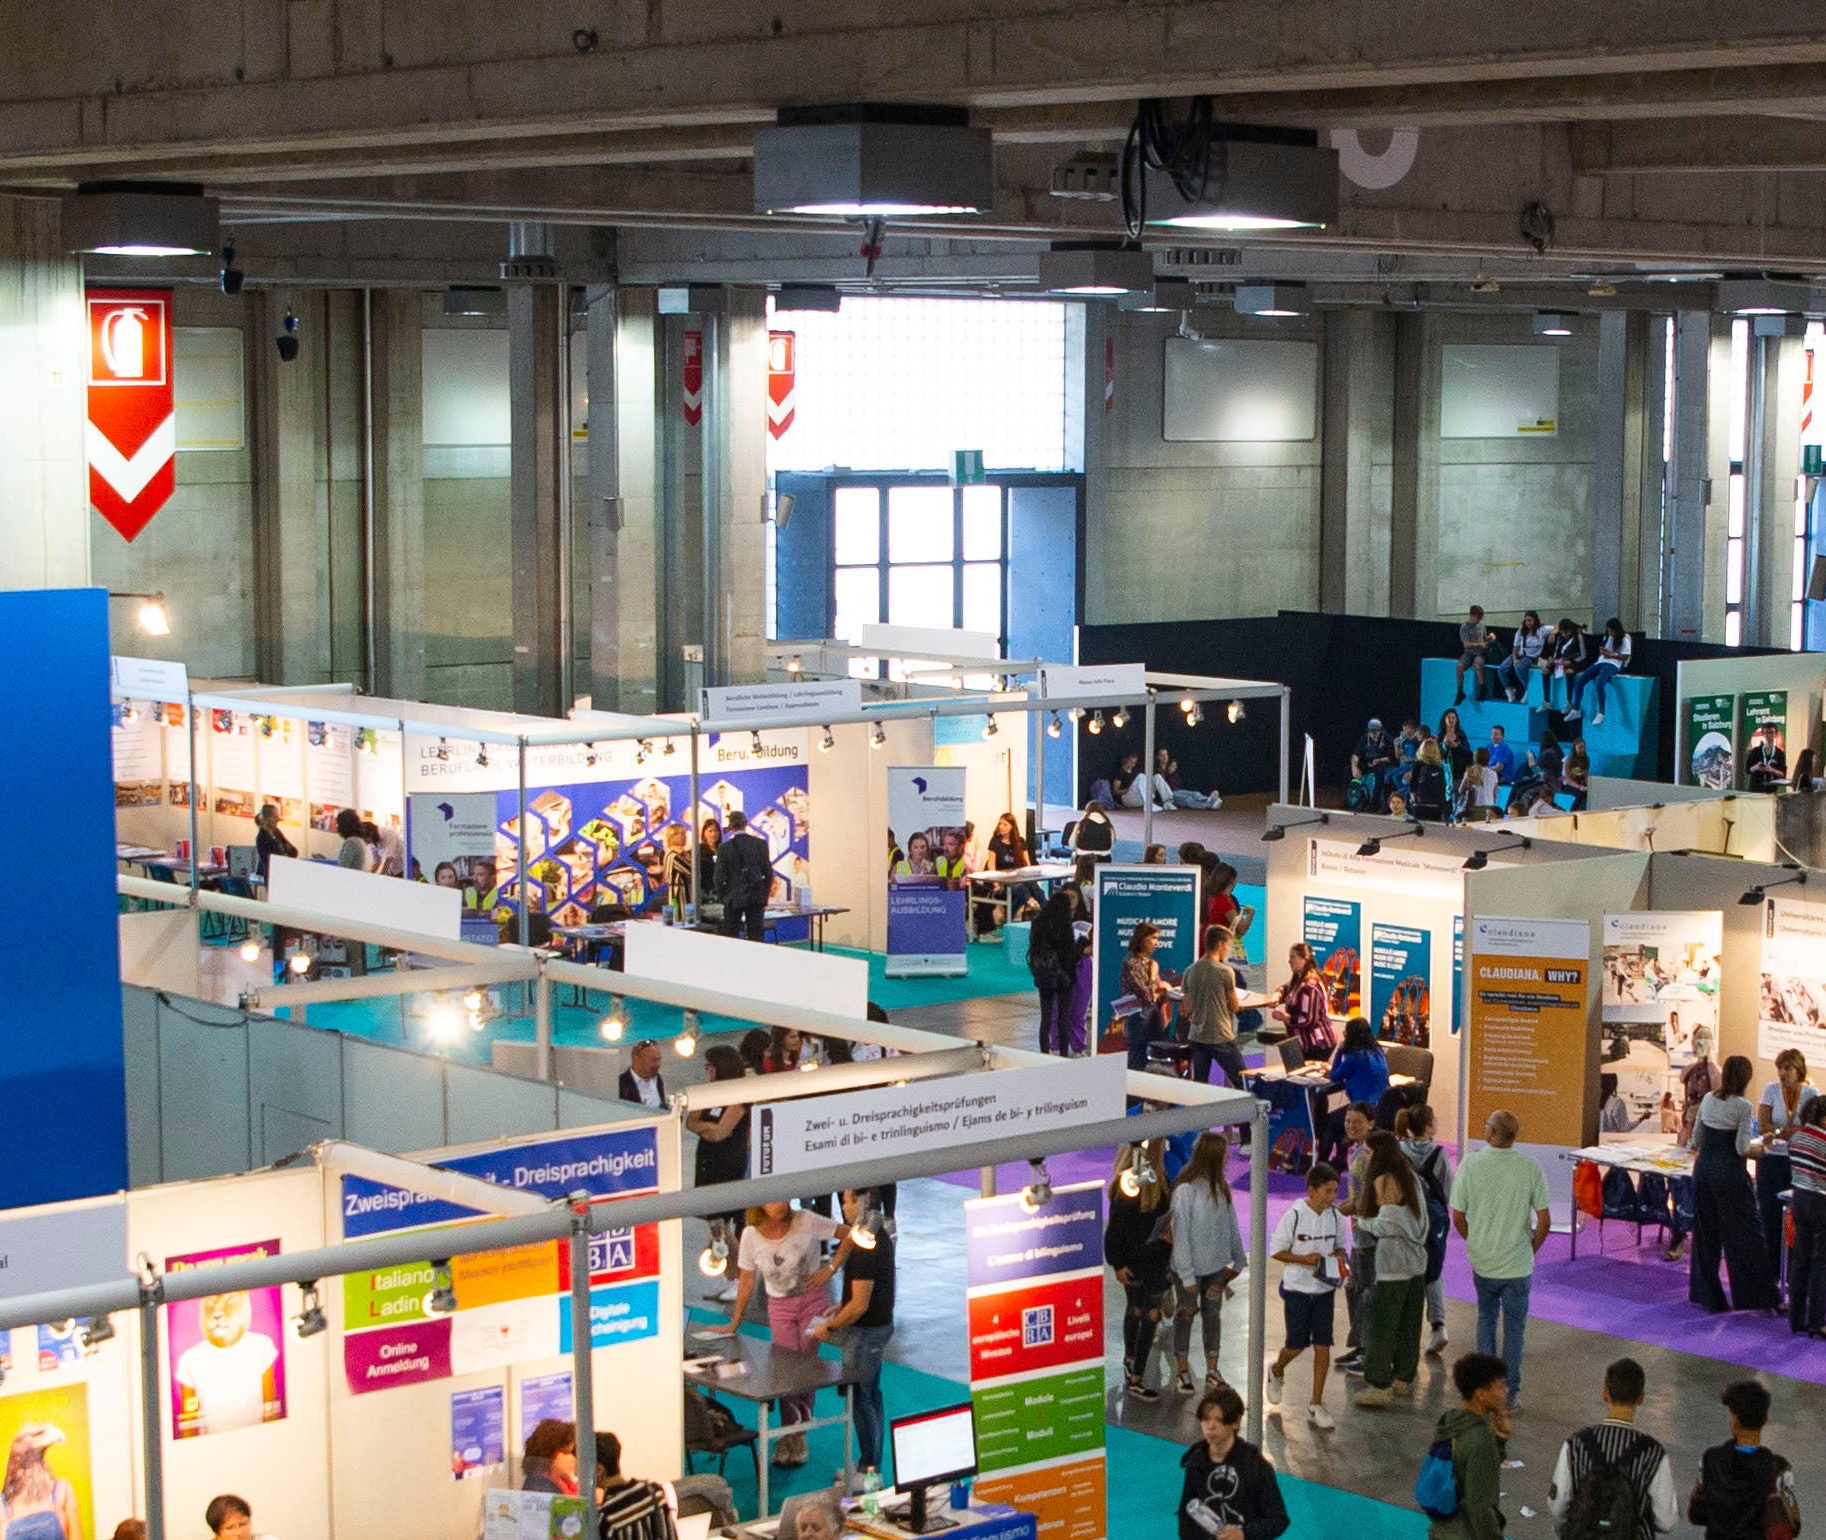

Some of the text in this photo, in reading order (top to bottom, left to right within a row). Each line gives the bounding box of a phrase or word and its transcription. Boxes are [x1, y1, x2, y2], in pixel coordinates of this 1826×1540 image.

[890, 895, 943, 906] LEHRLINGS-
[891, 904, 947, 915] AUSBILDUNG
[1488, 927, 1535, 938] claudiana
[1479, 965, 1579, 984] CLAUDIANA. WHY?
[805, 1093, 997, 1133] Zwei- u. Dreisprachigkeitsprüfungen
[804, 1136, 837, 1153] Esami
[840, 1131, 851, 1147] di
[853, 1129, 868, 1144] bi-
[871, 1132, 878, 1142] e
[961, 1111, 993, 1129] Ejams
[995, 1109, 1008, 1123] de
[1010, 1105, 1024, 1121] bi-
[1025, 1108, 1034, 1122] y
[1034, 1096, 1089, 1118] trilinguism
[514, 1148, 656, 1187] Dreisprachigkeit
[369, 1265, 435, 1292] Italiano
[369, 1296, 421, 1318] Ladin
[1075, 1297, 1083, 1308] 4
[992, 1314, 1000, 1324] 4
[379, 1342, 418, 1359] Online
[366, 1355, 430, 1378] Anmeldung
